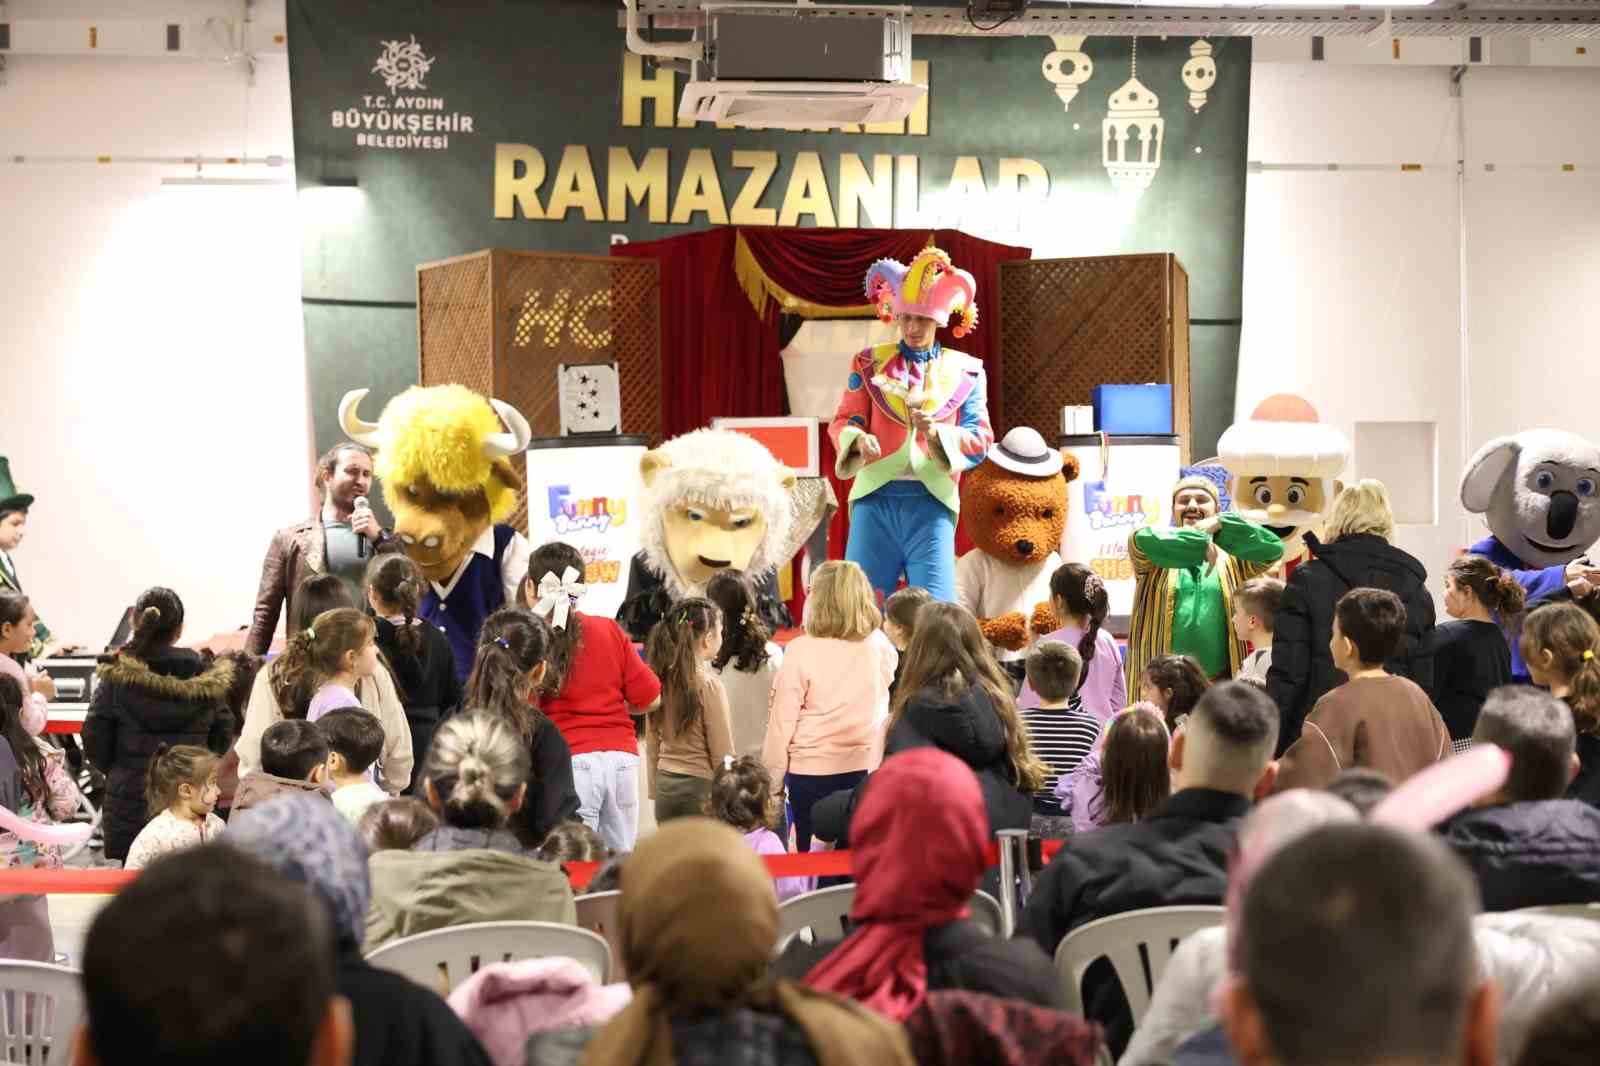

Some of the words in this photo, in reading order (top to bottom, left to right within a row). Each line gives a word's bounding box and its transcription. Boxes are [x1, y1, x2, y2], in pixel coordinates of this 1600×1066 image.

[363, 96, 391, 109] T.C.
[395, 97, 443, 110] AYDIN
[331, 108, 473, 134] BÜYÜKŞEHİR
[356, 132, 448, 149] BELEDİYESİ
[548, 484, 627, 527] Funny
[1090, 557, 1134, 580] SHO
